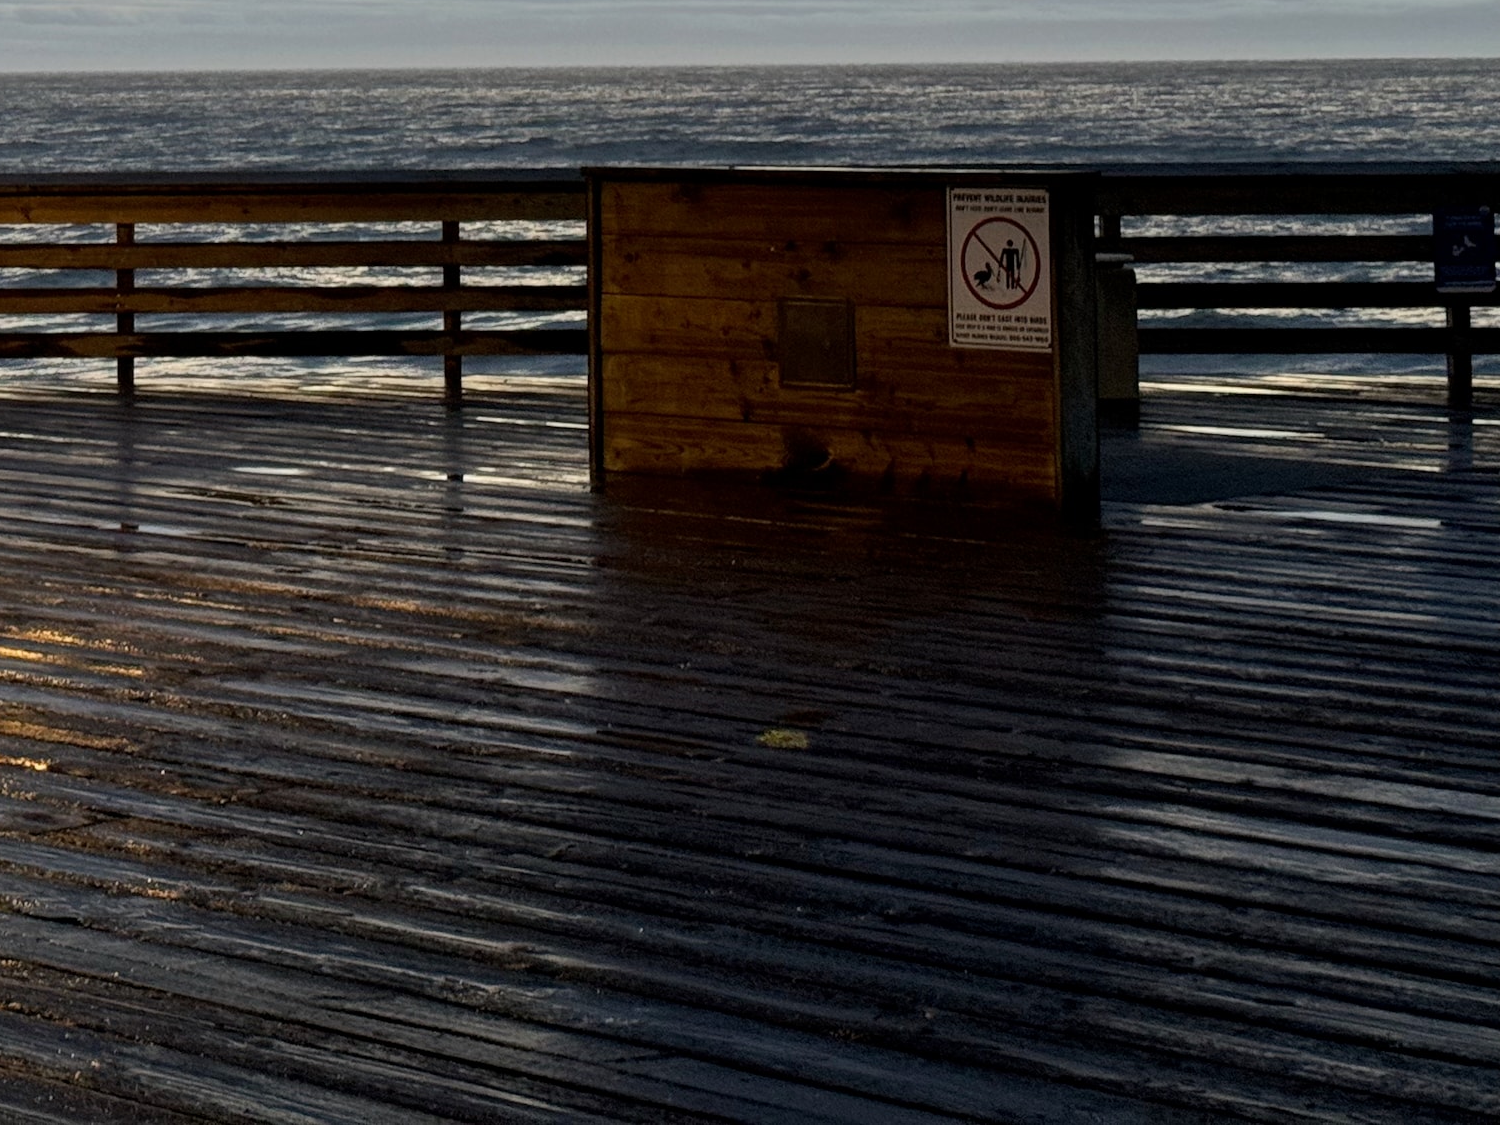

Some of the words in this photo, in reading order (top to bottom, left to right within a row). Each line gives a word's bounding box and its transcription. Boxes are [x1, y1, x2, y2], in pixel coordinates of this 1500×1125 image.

[953, 193, 982, 202] PREVENT
[984, 194, 1014, 203] WILDLIFE
[1016, 195, 1046, 204] INJURIES
[956, 313, 977, 322] PLEASE
[979, 314, 995, 322] DON'T
